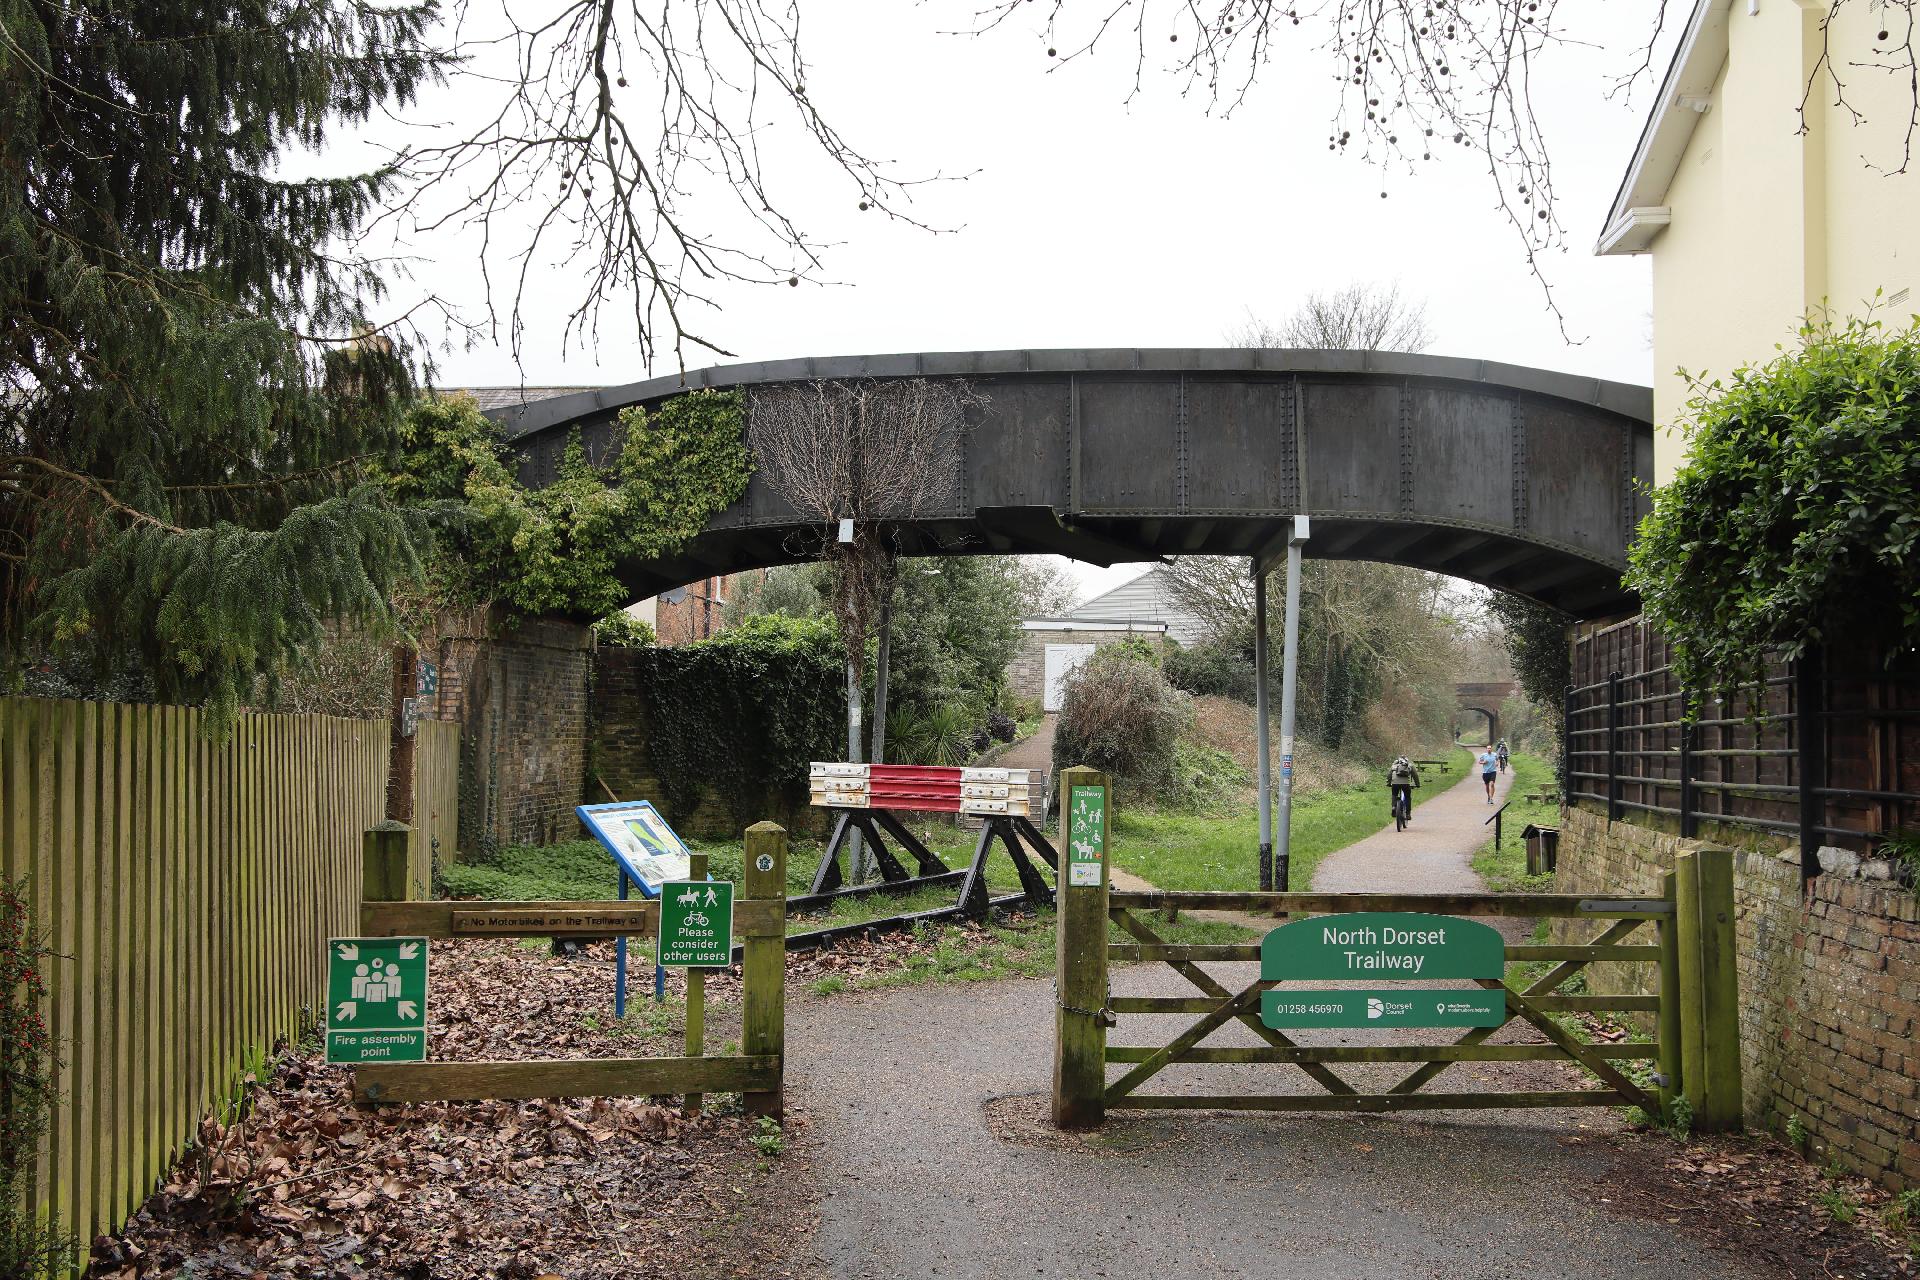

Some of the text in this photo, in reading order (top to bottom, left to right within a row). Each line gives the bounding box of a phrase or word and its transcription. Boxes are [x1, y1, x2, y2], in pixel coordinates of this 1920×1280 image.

[1074, 790, 1102, 799] Trailway
[471, 917, 486, 926] No
[548, 918, 562, 926] on
[566, 916, 582, 926] the
[585, 916, 627, 926] Trailway
[678, 927, 714, 937] Please
[1323, 926, 1446, 945] North Dorset
[671, 939, 719, 949] consider
[663, 951, 726, 961] other users
[1343, 950, 1425, 974] Trailway
[1277, 1004, 1343, 1014] 01258 456970
[1385, 1002, 1413, 1010] Dorset
[335, 1034, 417, 1045] Fire assembly
[360, 1046, 391, 1059] point
